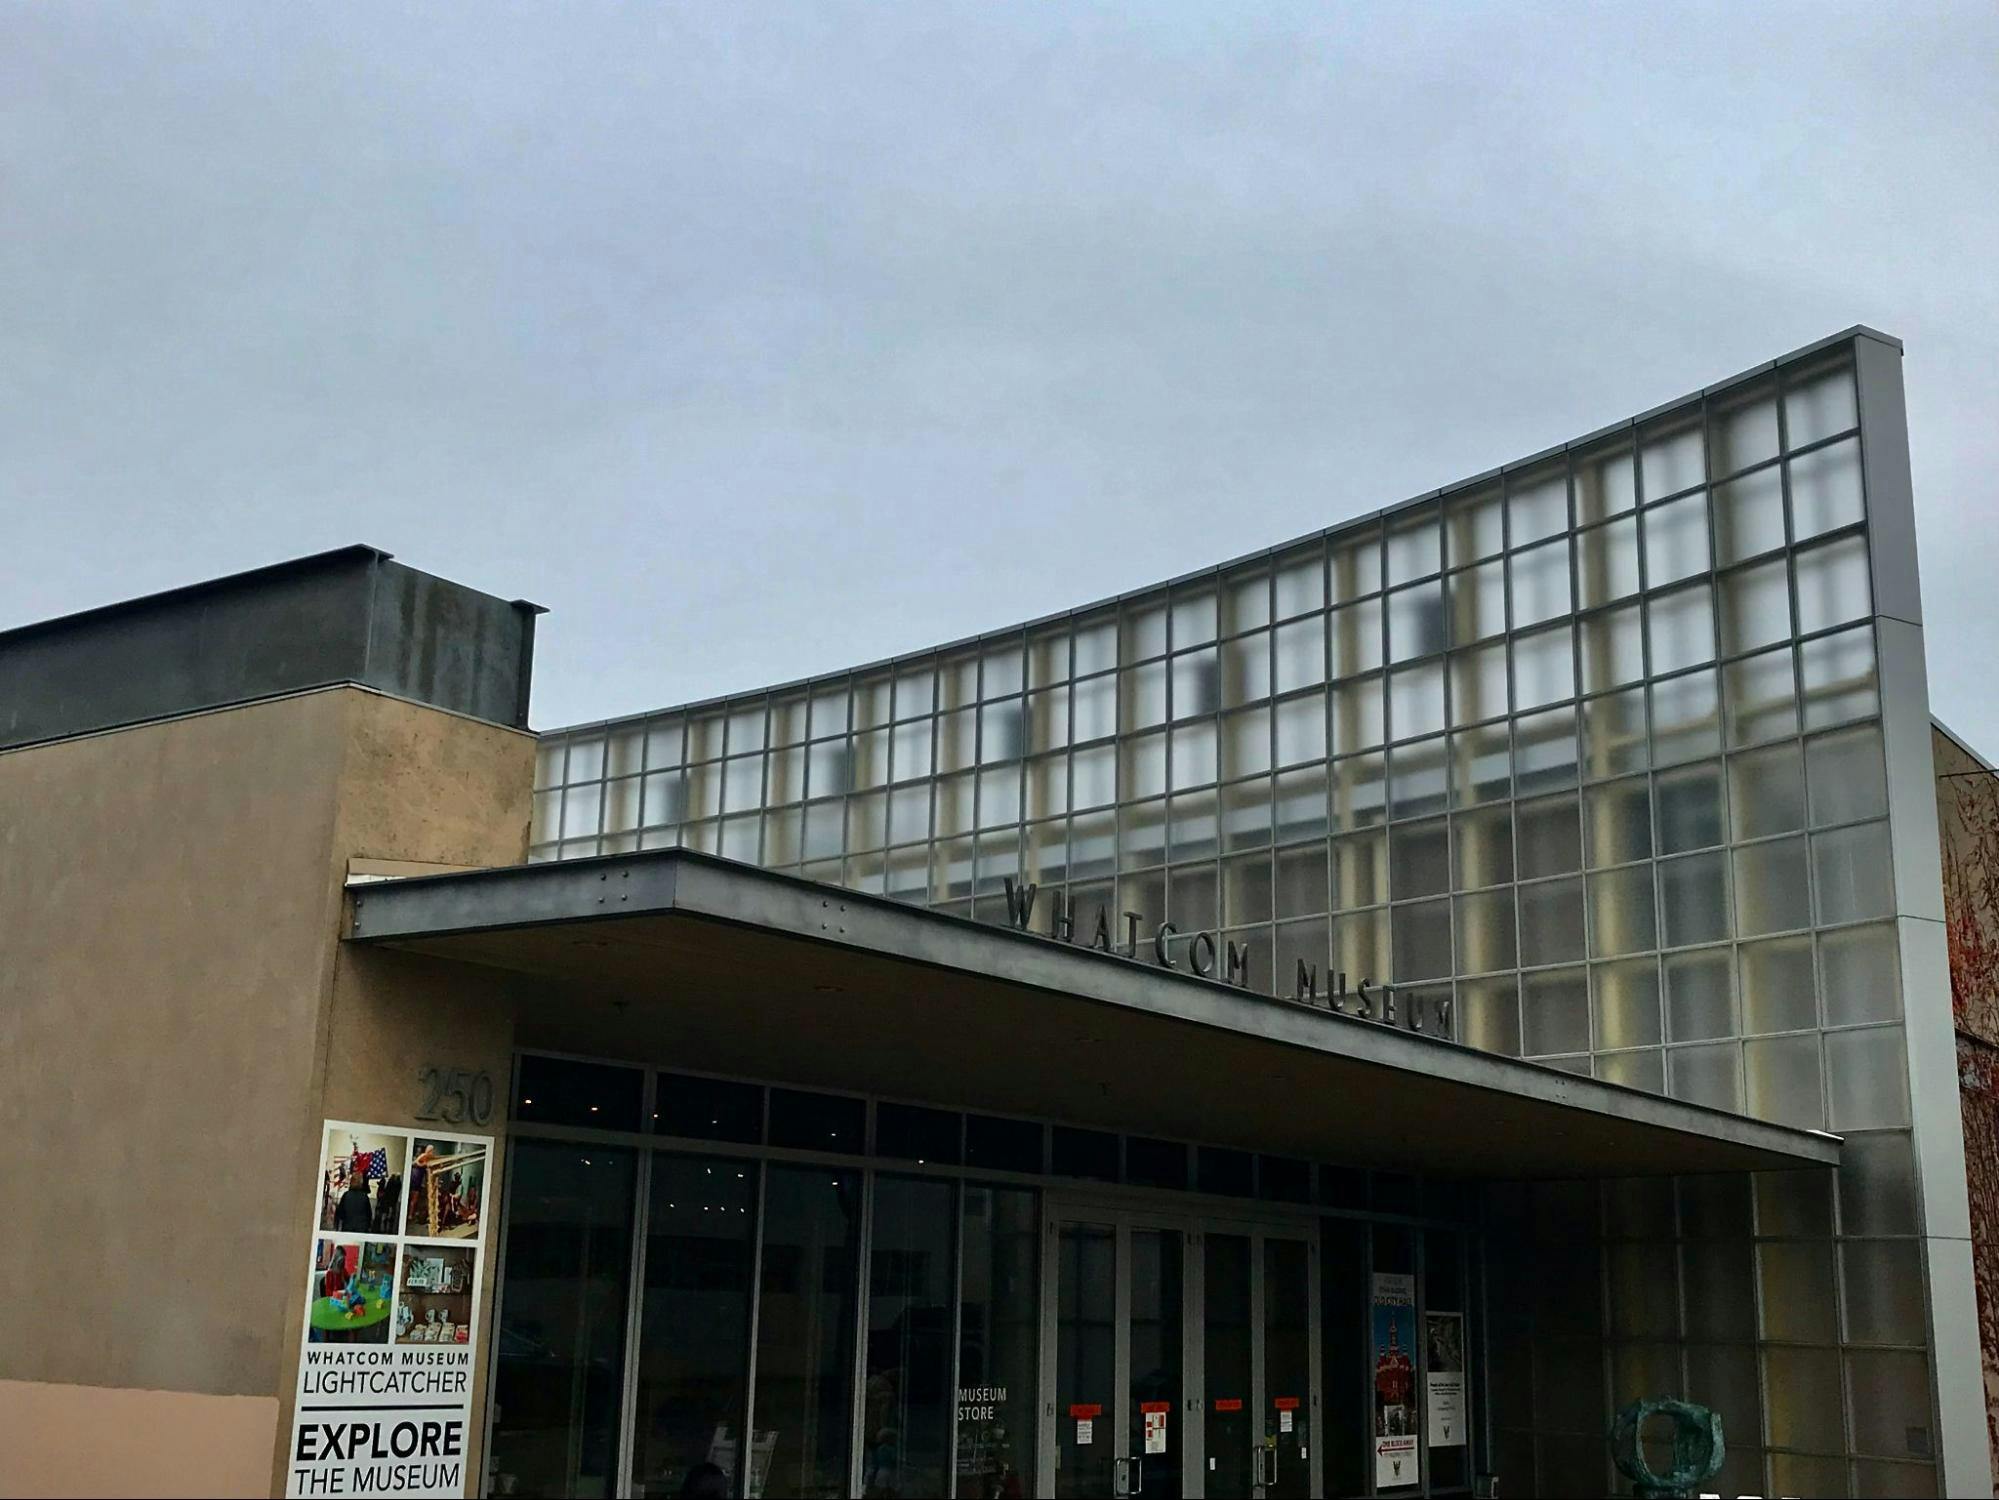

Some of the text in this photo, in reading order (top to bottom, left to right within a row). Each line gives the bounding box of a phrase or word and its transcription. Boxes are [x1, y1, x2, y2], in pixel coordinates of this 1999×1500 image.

[1003, 877, 1452, 1040] WHATCOM MUSEUM
[414, 1068, 495, 1127] 250
[307, 1351, 470, 1366] WHATCOM MUSEUM
[303, 1369, 467, 1395] LIGHTCATCHER
[958, 1387, 1007, 1402] MUSEUM
[958, 1406, 995, 1421] STORE
[296, 1420, 463, 1461] EXPLORE
[294, 1463, 460, 1495] THE MUSEUM
